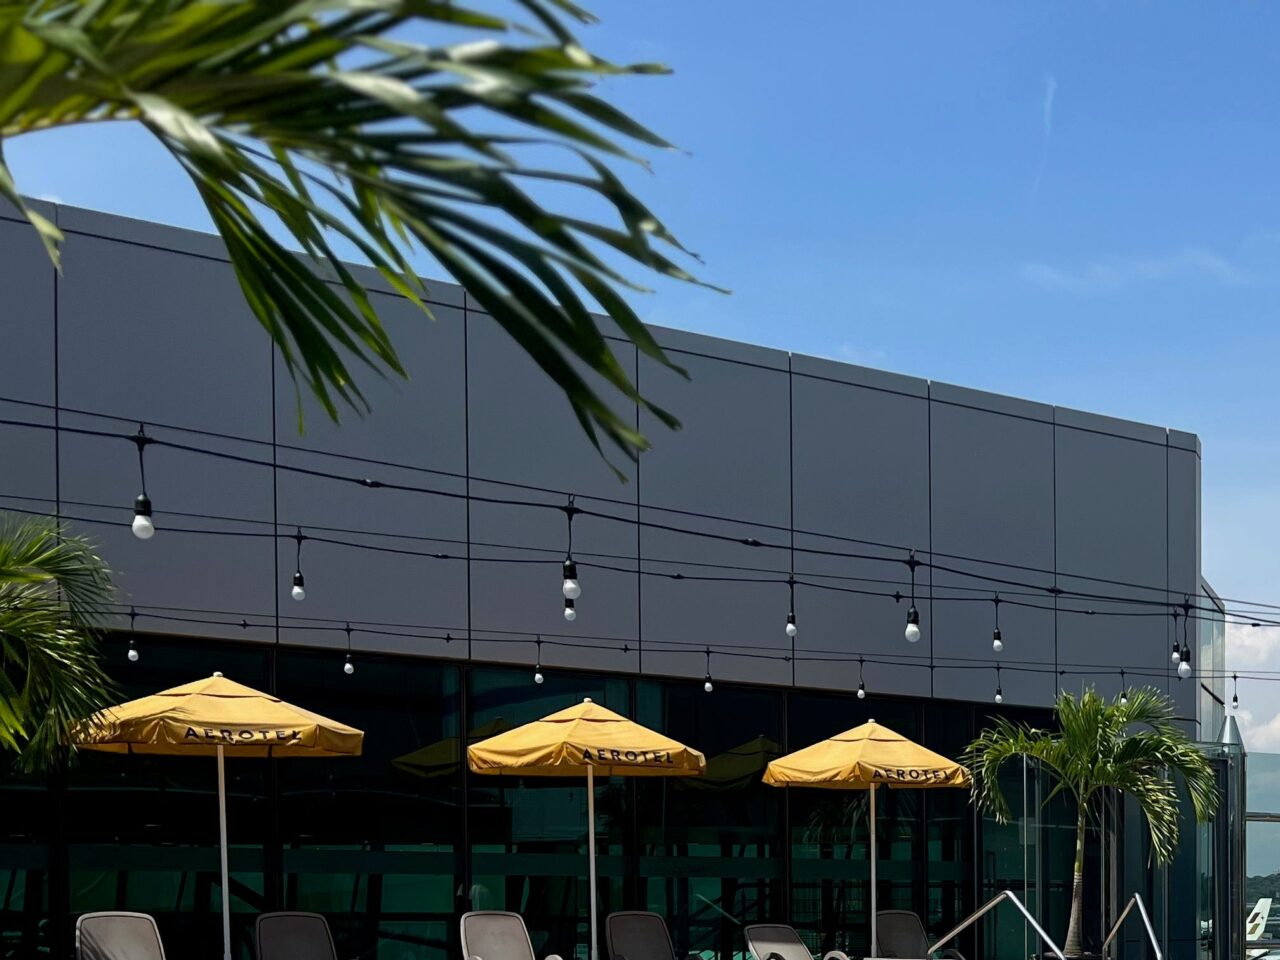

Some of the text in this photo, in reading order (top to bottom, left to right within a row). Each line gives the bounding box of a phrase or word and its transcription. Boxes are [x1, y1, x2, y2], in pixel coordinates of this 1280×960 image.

[184, 726, 303, 741] AEROTEL
[582, 748, 674, 763] AEROTEL
[872, 767, 951, 780] AEROTEL
